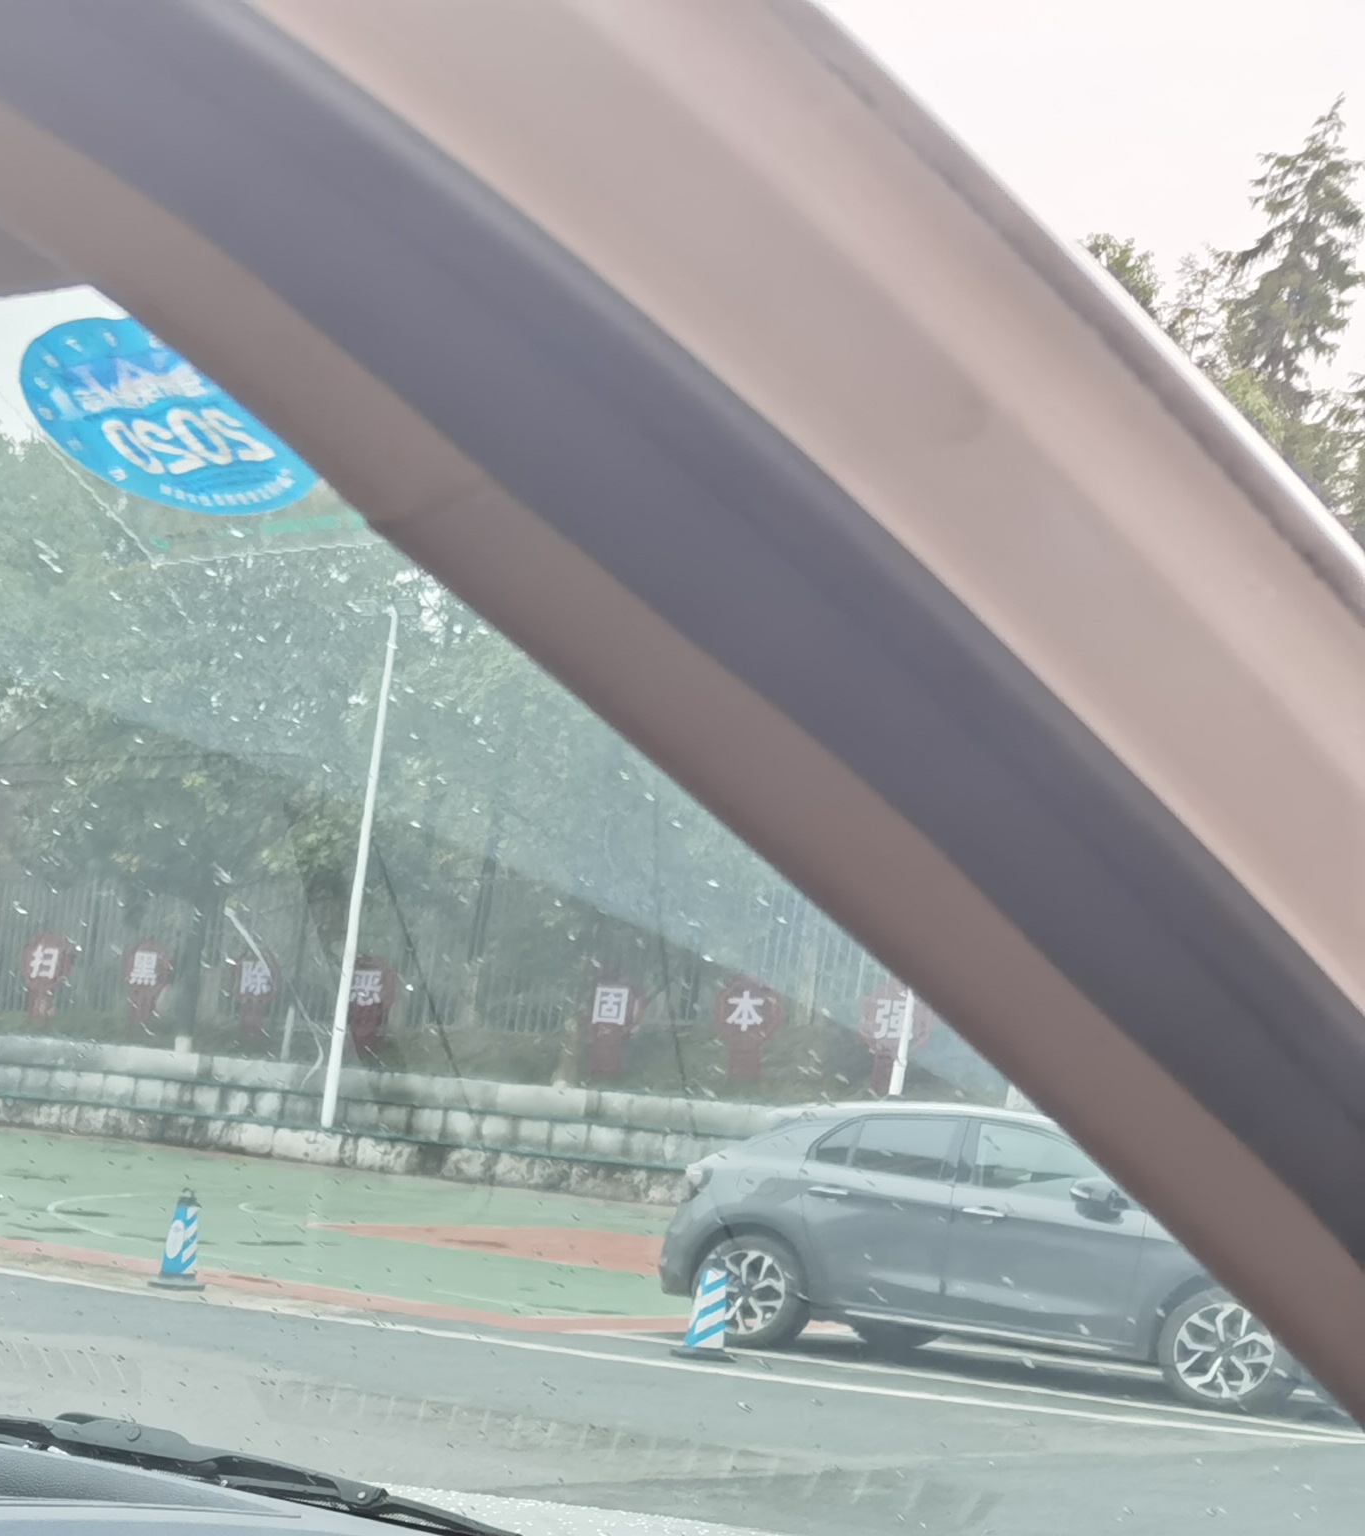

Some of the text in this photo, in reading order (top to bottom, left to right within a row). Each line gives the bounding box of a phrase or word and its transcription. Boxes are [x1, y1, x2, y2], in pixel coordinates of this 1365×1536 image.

[29, 944, 60, 980] 扫
[128, 950, 159, 987] 黑
[239, 959, 273, 996] 除
[349, 970, 383, 1007] 恶
[591, 986, 630, 1026] 固
[725, 989, 765, 1032] 本
